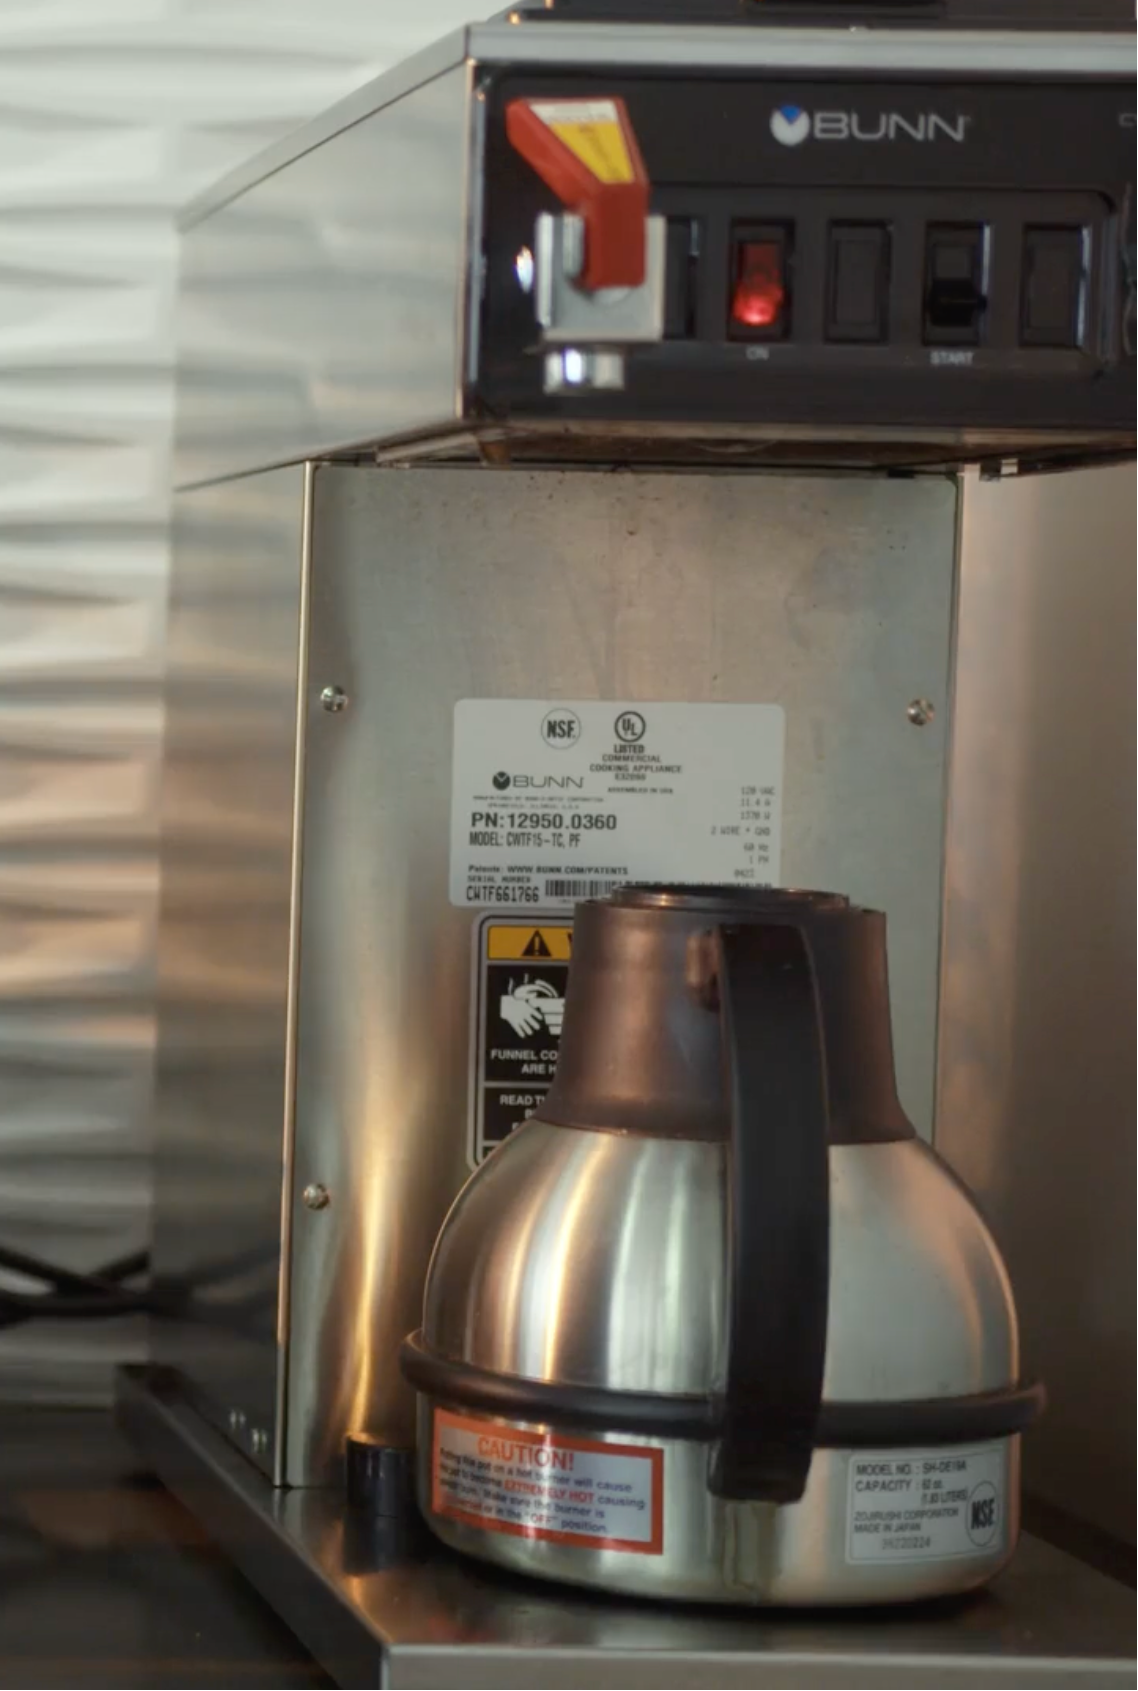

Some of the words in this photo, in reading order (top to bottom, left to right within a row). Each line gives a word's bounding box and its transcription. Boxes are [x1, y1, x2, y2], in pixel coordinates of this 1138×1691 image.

[813, 112, 965, 141] BUNN
[930, 352, 974, 366] START
[613, 744, 645, 754] LISTED
[602, 755, 661, 763] COMMERCIAL
[589, 764, 629, 772] COOKING
[632, 765, 682, 774] APPLIANCE
[513, 775, 584, 789] BUNN
[469, 832, 503, 846] MODEL:
[569, 834, 581, 847] PF
[491, 1049, 537, 1060] FUNNEL
[521, 1064, 546, 1074] ARE
[500, 1095, 533, 1106] READ
[477, 1436, 575, 1471] CAUTION!
[856, 1464, 893, 1476] MODEL
[574, 1479, 593, 1489] will
[597, 1482, 632, 1492] cause
[856, 1479, 912, 1492] CAPACITY
[568, 1492, 595, 1503] HOT
[597, 1498, 646, 1511] causing
[554, 1502, 592, 1517] burner
